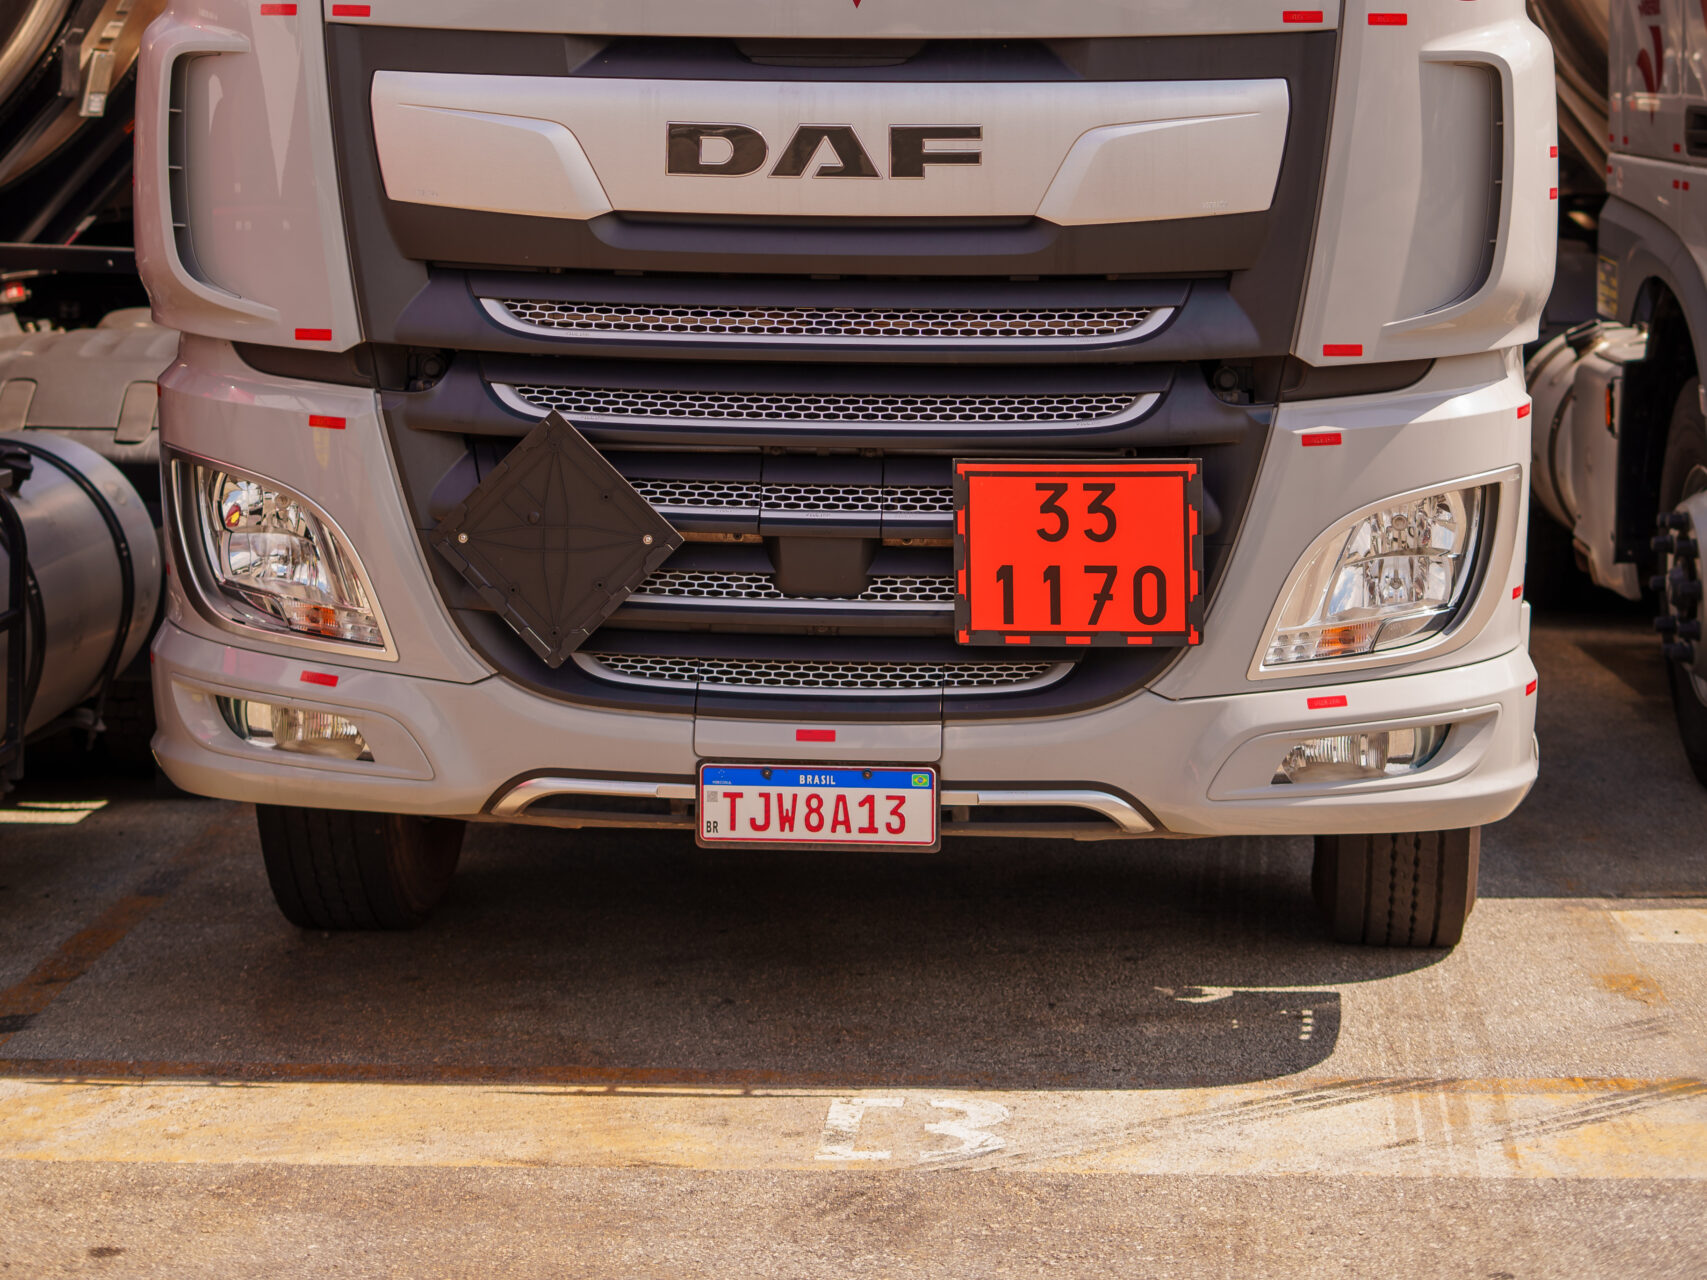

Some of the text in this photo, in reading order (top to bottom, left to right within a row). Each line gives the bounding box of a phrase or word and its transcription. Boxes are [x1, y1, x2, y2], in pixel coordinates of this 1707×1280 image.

[665, 121, 983, 180] DAF
[1035, 483, 1117, 542] 33
[996, 565, 1167, 625] 1170
[799, 775, 836, 785] BRASIL
[706, 821, 719, 833] BR
[723, 792, 906, 834] TJW8A13
